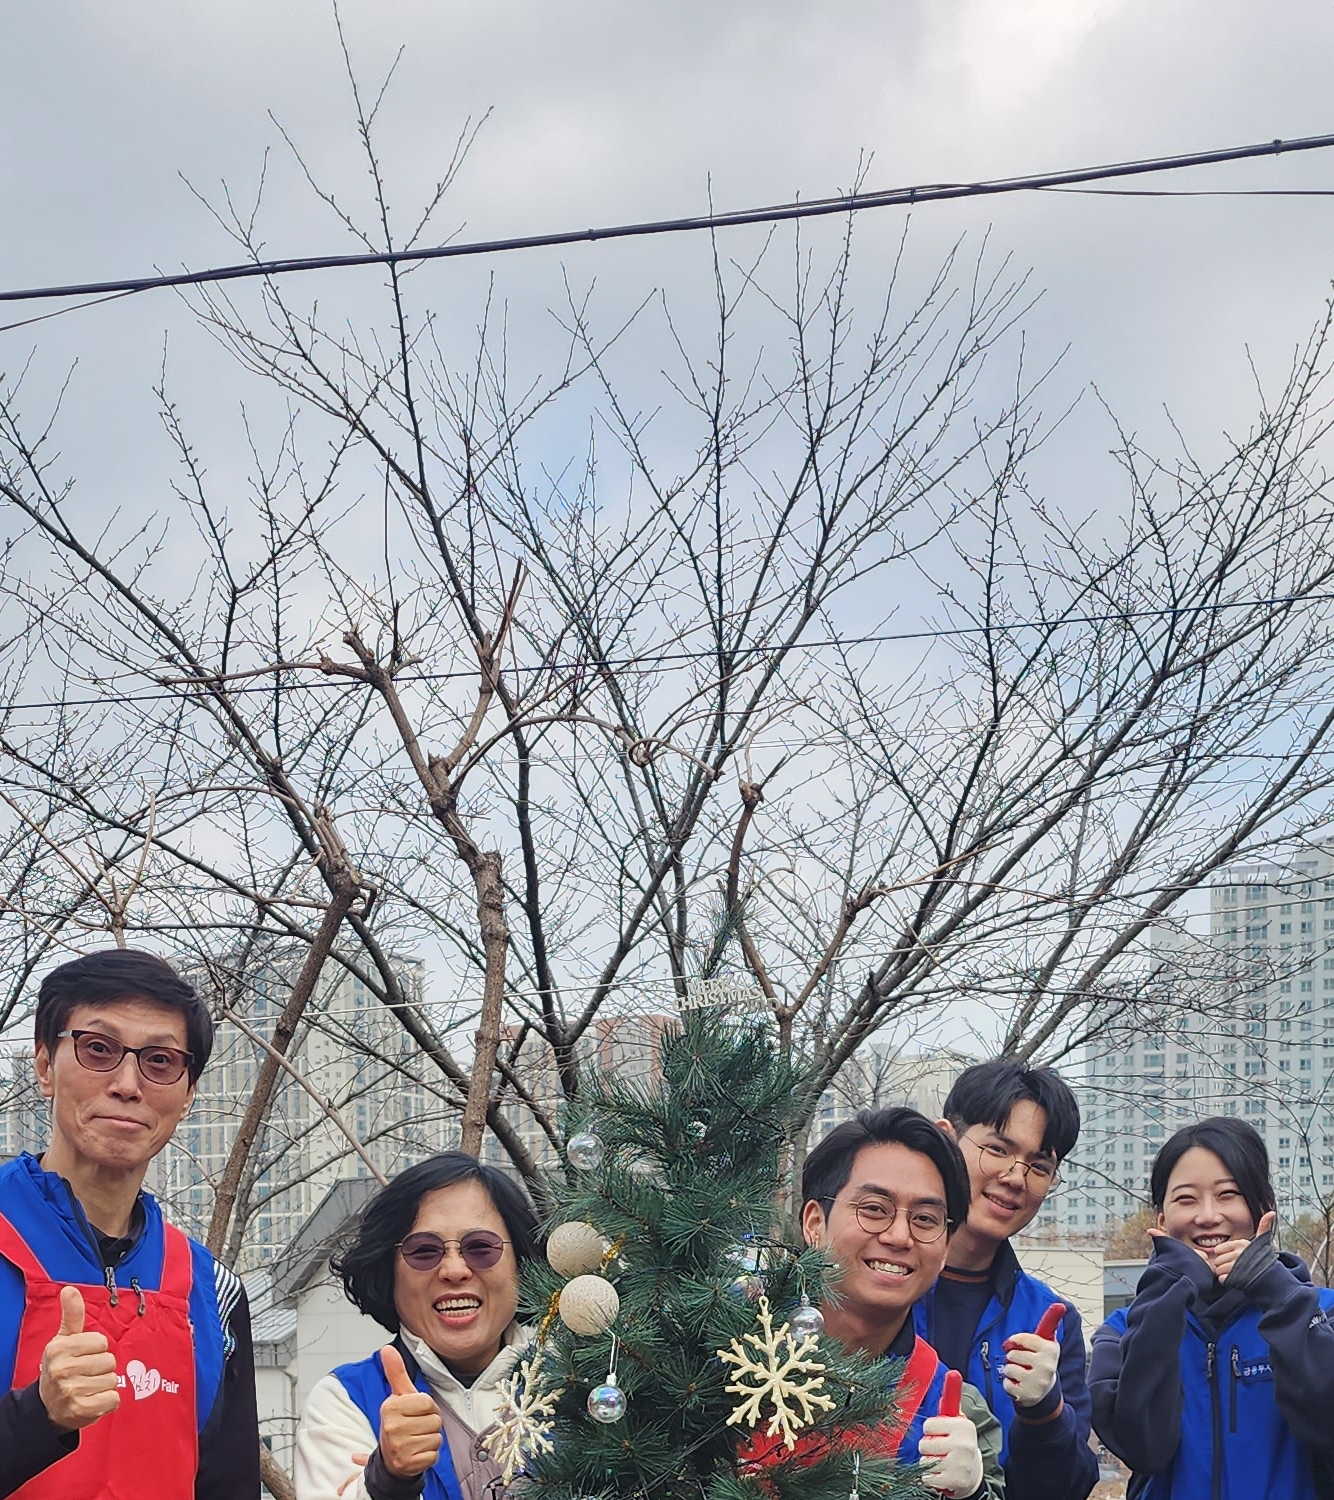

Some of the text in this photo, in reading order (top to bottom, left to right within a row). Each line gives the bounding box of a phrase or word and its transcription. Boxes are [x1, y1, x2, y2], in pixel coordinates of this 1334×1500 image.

[686, 975, 744, 996] MERRY
[673, 985, 764, 1011] CHRISTMAS
[130, 1372, 157, 1393] 김치
[161, 1378, 180, 1394] Fair
